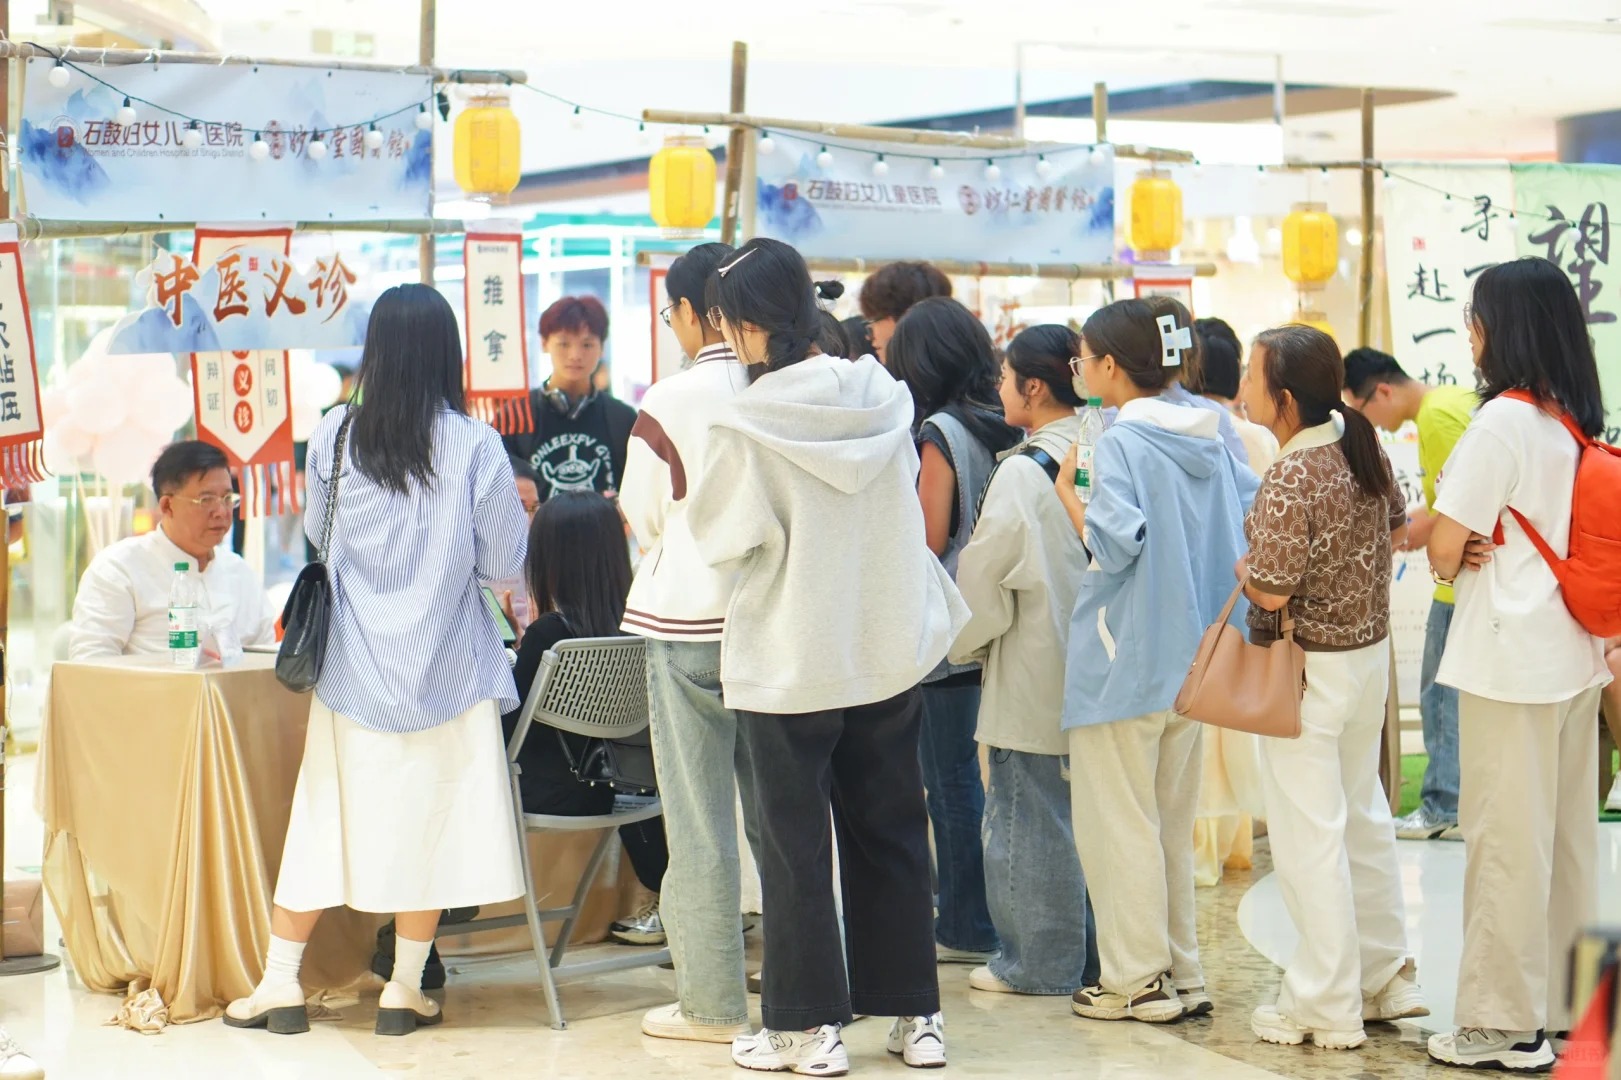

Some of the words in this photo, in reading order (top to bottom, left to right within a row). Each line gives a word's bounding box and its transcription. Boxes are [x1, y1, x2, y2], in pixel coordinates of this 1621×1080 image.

[807, 179, 942, 205] 石鼓妇女儿童医院
[154, 254, 357, 327] 中医义诊
[484, 275, 507, 362] 推拿
